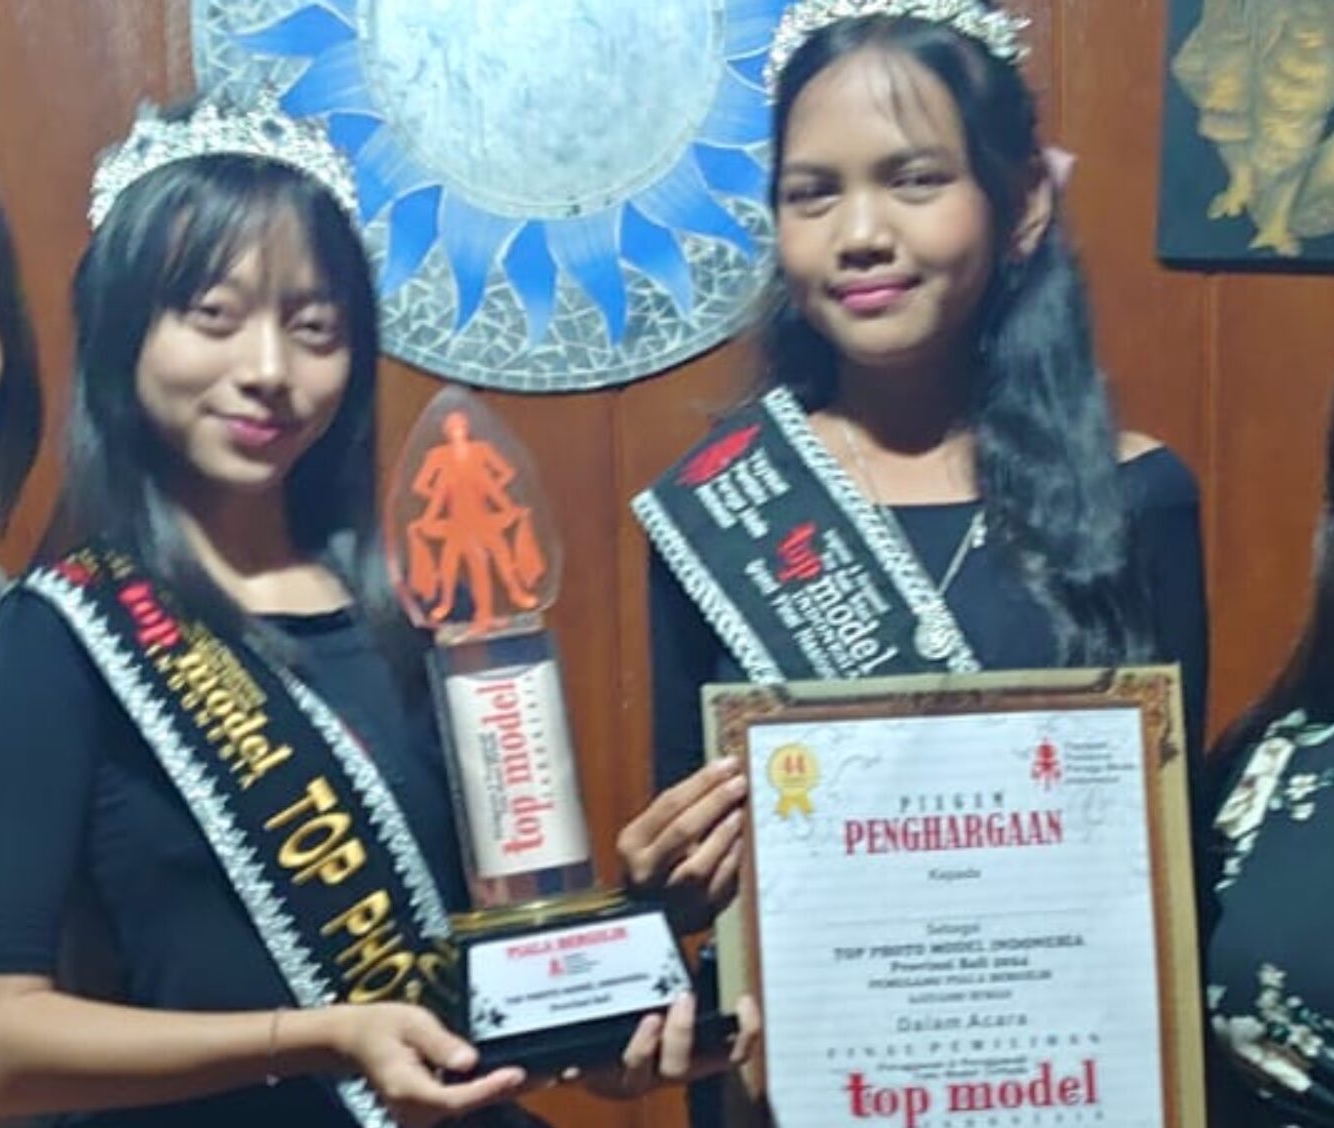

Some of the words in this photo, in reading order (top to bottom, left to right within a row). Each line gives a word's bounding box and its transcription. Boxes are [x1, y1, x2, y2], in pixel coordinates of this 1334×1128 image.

[806, 576, 900, 675] model
[118, 579, 182, 648] top
[172, 652, 294, 773] model
[475, 681, 533, 784] model
[263, 774, 368, 885] TOP
[501, 796, 556, 856] top
[845, 809, 1064, 855] PENGHARGAAN
[966, 1012, 1028, 1029] Acara
[946, 1058, 1099, 1113] model
